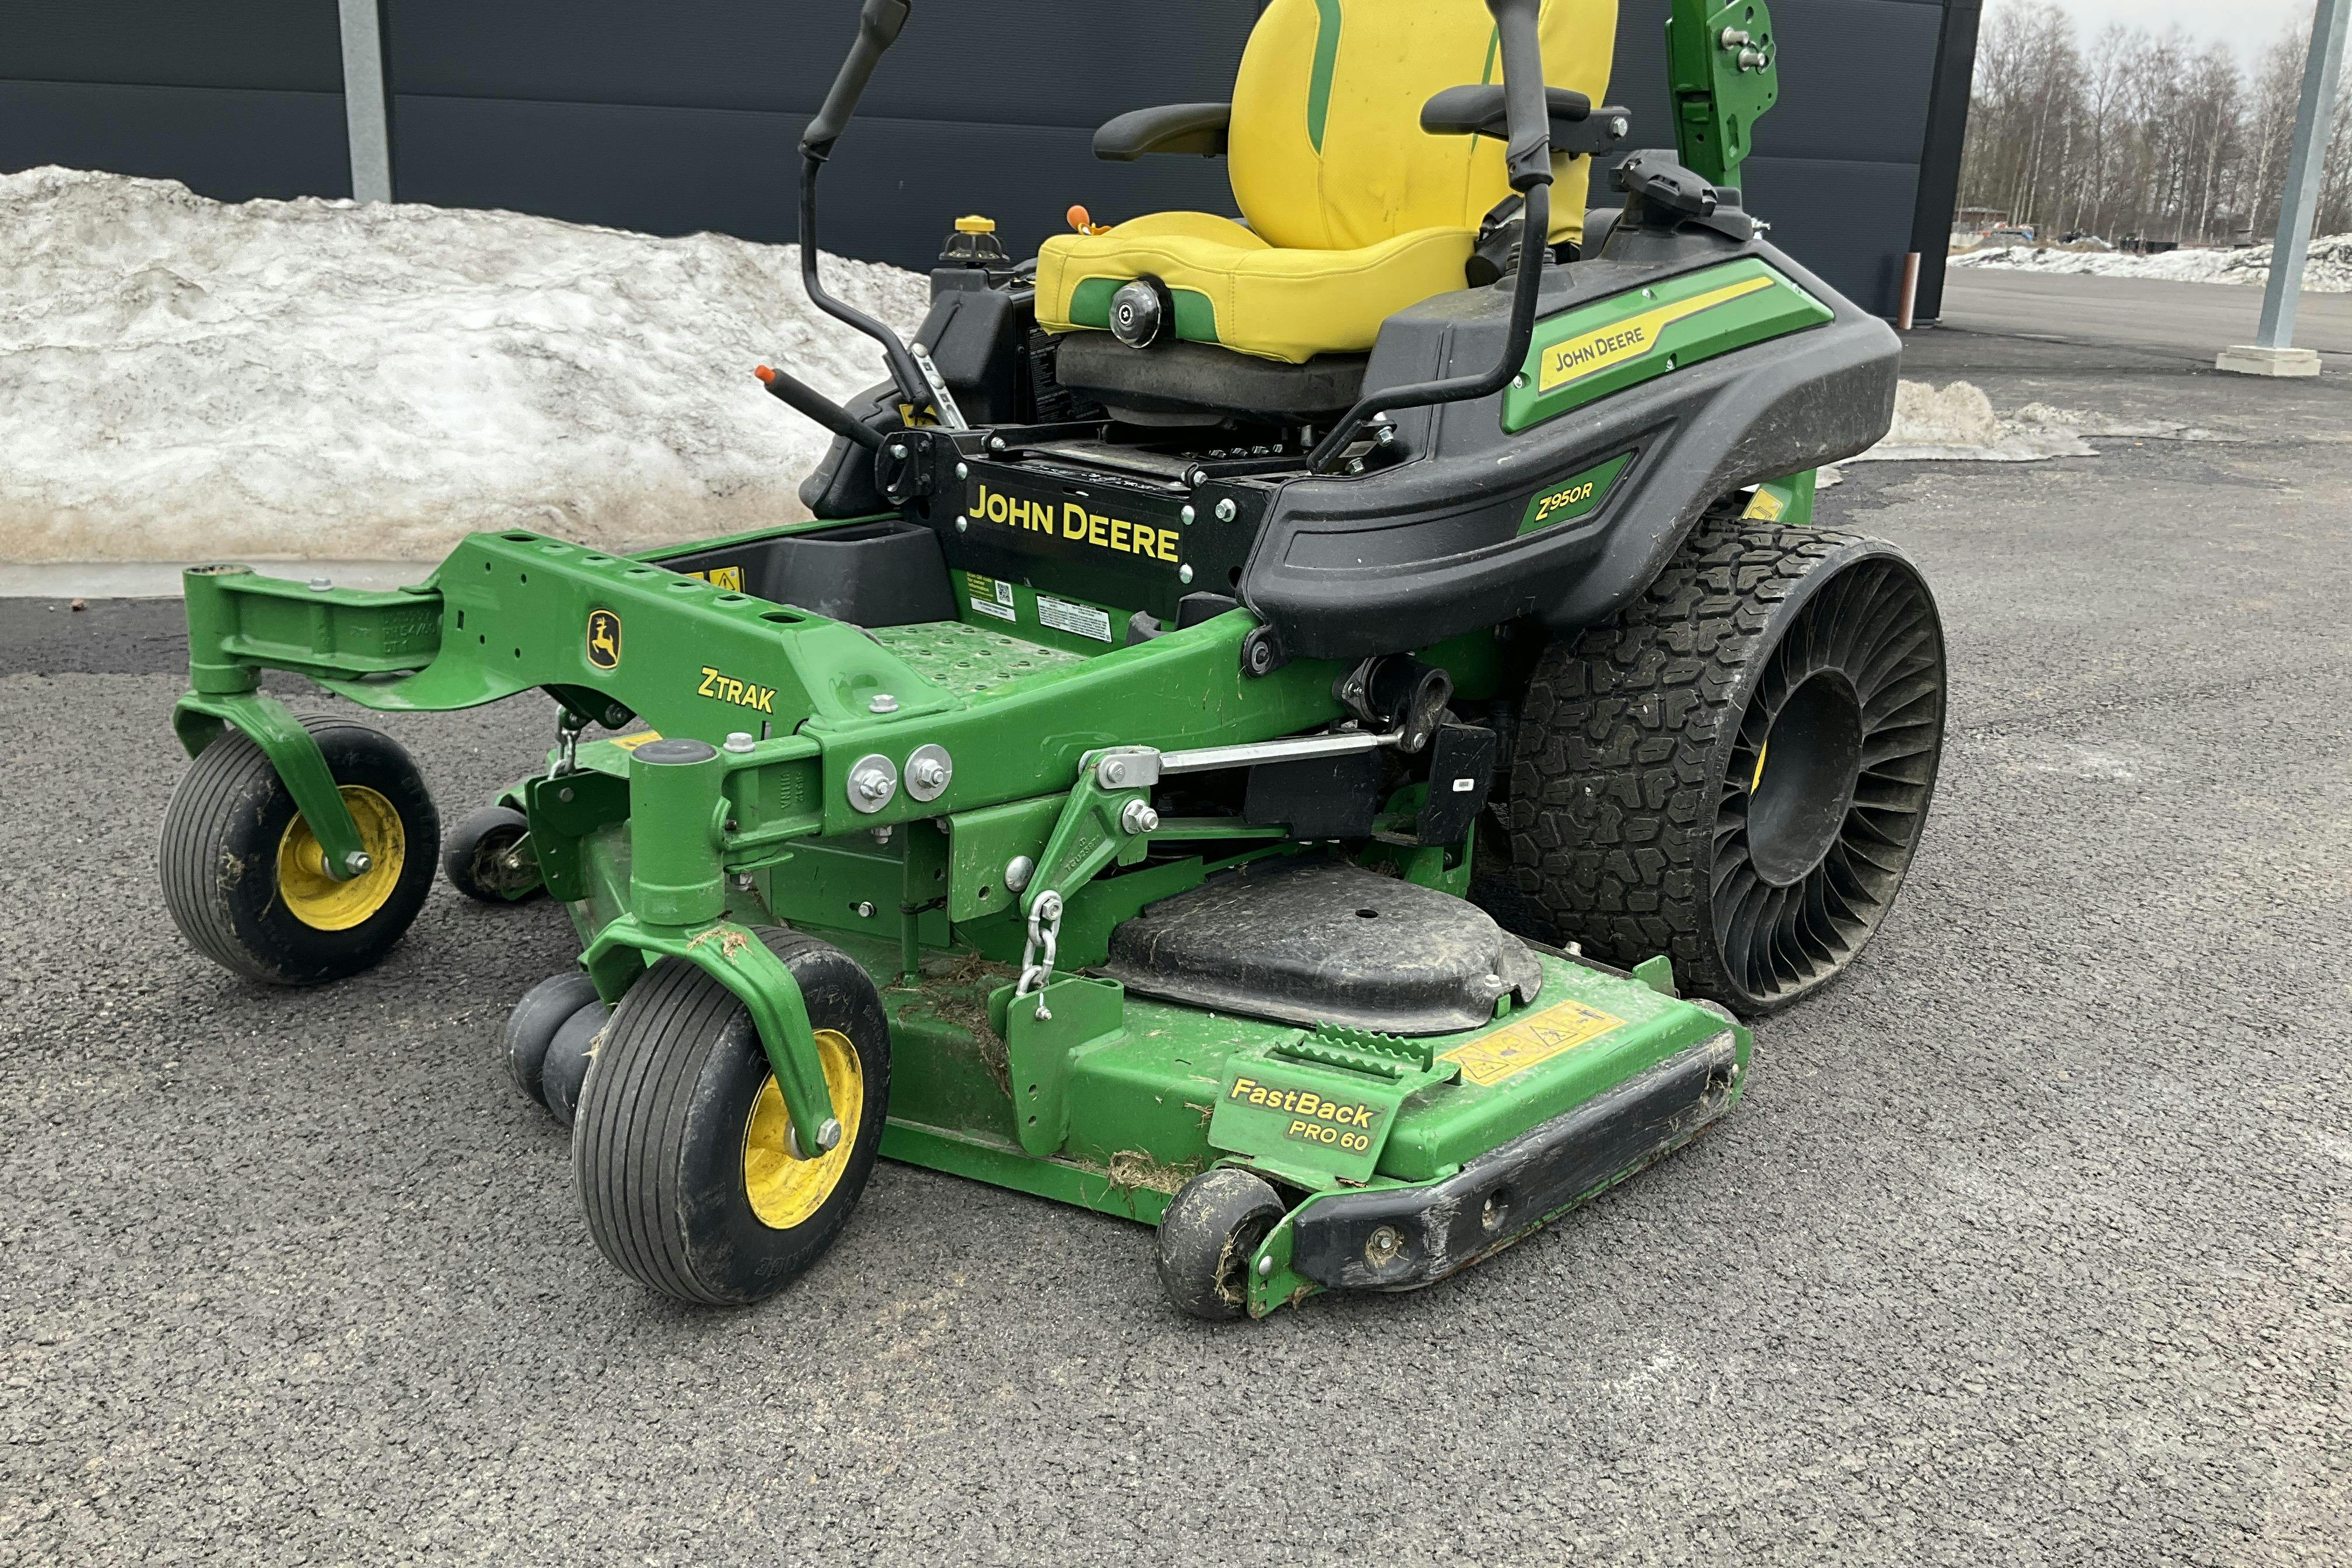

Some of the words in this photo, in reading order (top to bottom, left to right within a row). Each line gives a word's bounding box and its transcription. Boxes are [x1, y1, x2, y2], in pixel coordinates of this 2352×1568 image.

[1556, 345, 1595, 372] JOHN
[1595, 327, 1644, 356] DEERE
[969, 485, 1054, 535] JOHN
[1063, 503, 1179, 562] DEERE
[1535, 481, 1593, 522] Z950R
[697, 666, 776, 715] ZTRAK
[1230, 1077, 1374, 1129] FastBack
[1288, 1119, 1338, 1143] PRO
[1340, 1132, 1369, 1151] 60
